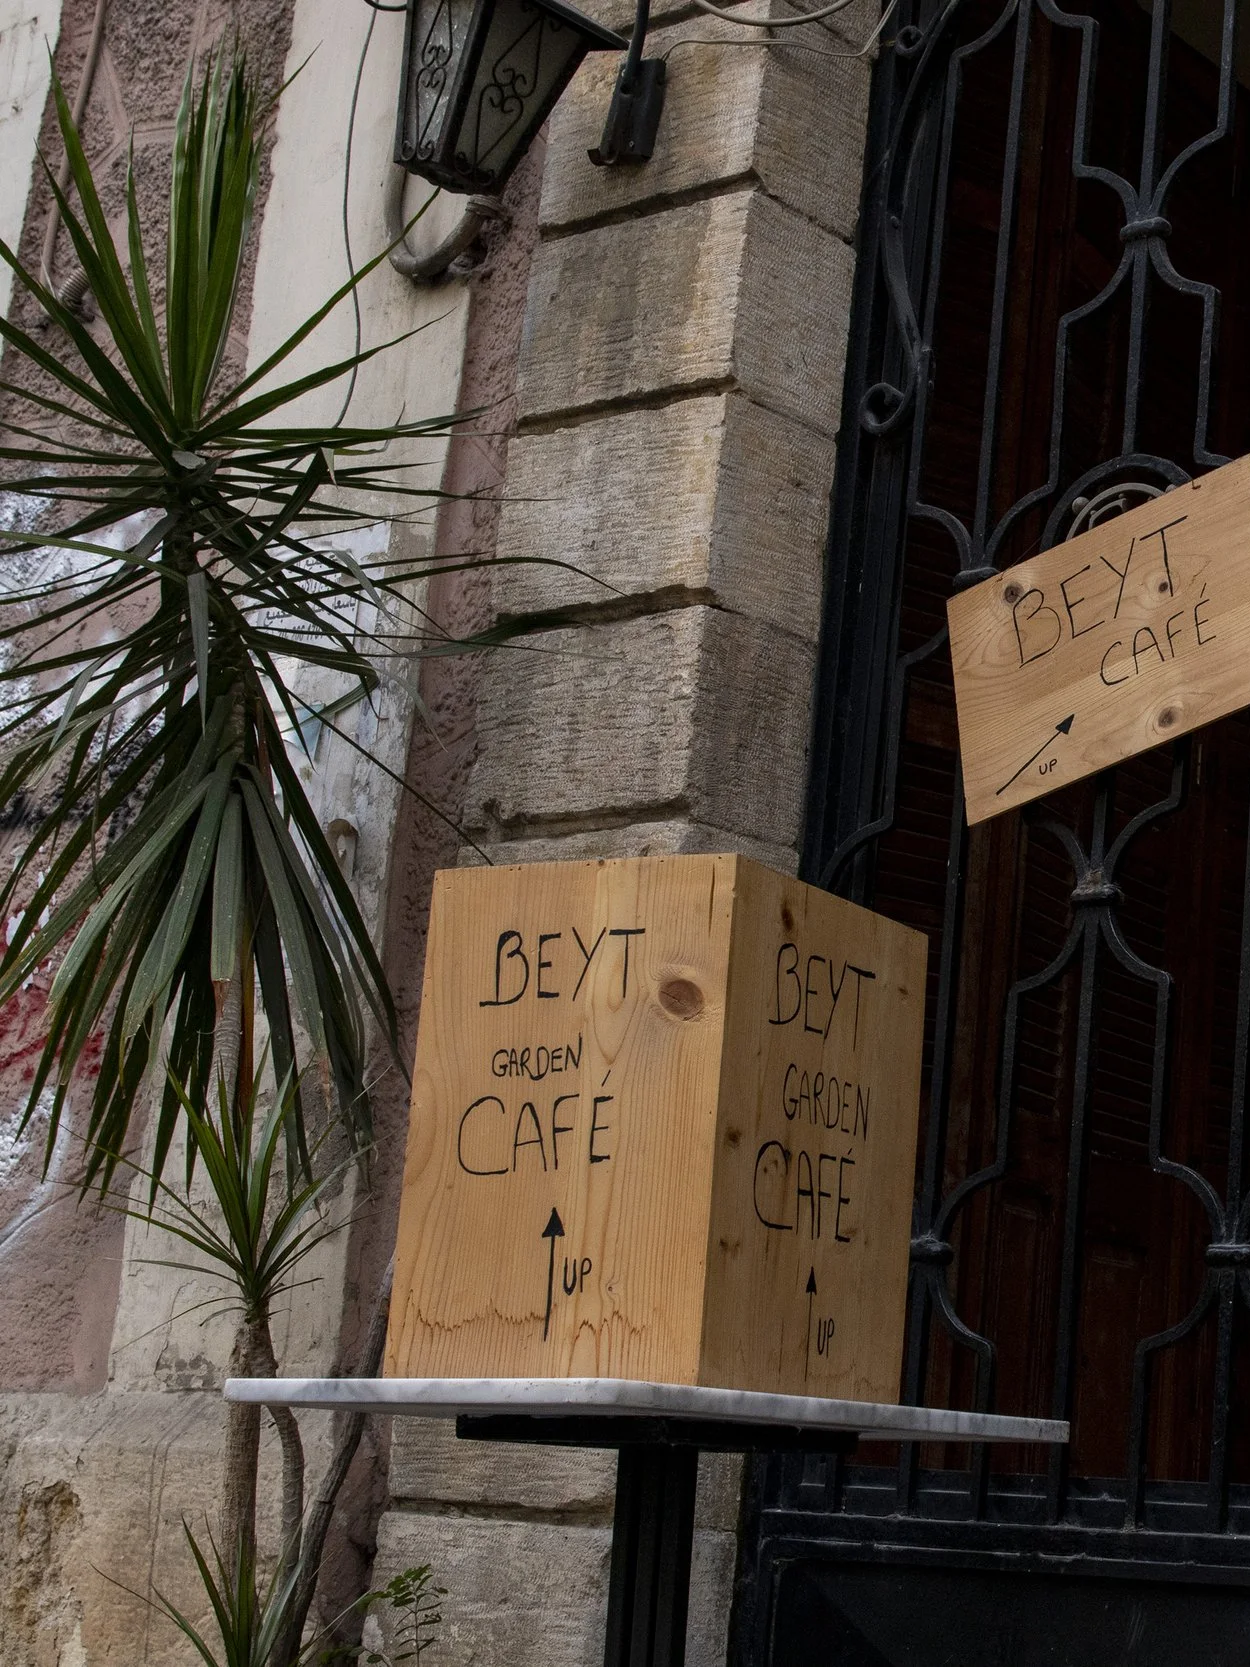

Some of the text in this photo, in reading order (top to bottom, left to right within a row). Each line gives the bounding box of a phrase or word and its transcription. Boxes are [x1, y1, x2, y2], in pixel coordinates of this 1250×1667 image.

[1012, 515, 1189, 669] BEYT
[1100, 582, 1217, 686] CAFÉ
[1038, 758, 1058, 776] UP
[479, 926, 646, 1007] BEYT
[768, 941, 876, 1052] BEYT
[491, 1032, 583, 1081] GARDEN
[457, 1069, 614, 1176] CAFÉ
[782, 1062, 871, 1142] GARDEN
[753, 1140, 856, 1243] CAFÉ
[562, 1257, 593, 1296] UP
[818, 1317, 835, 1357] UP
